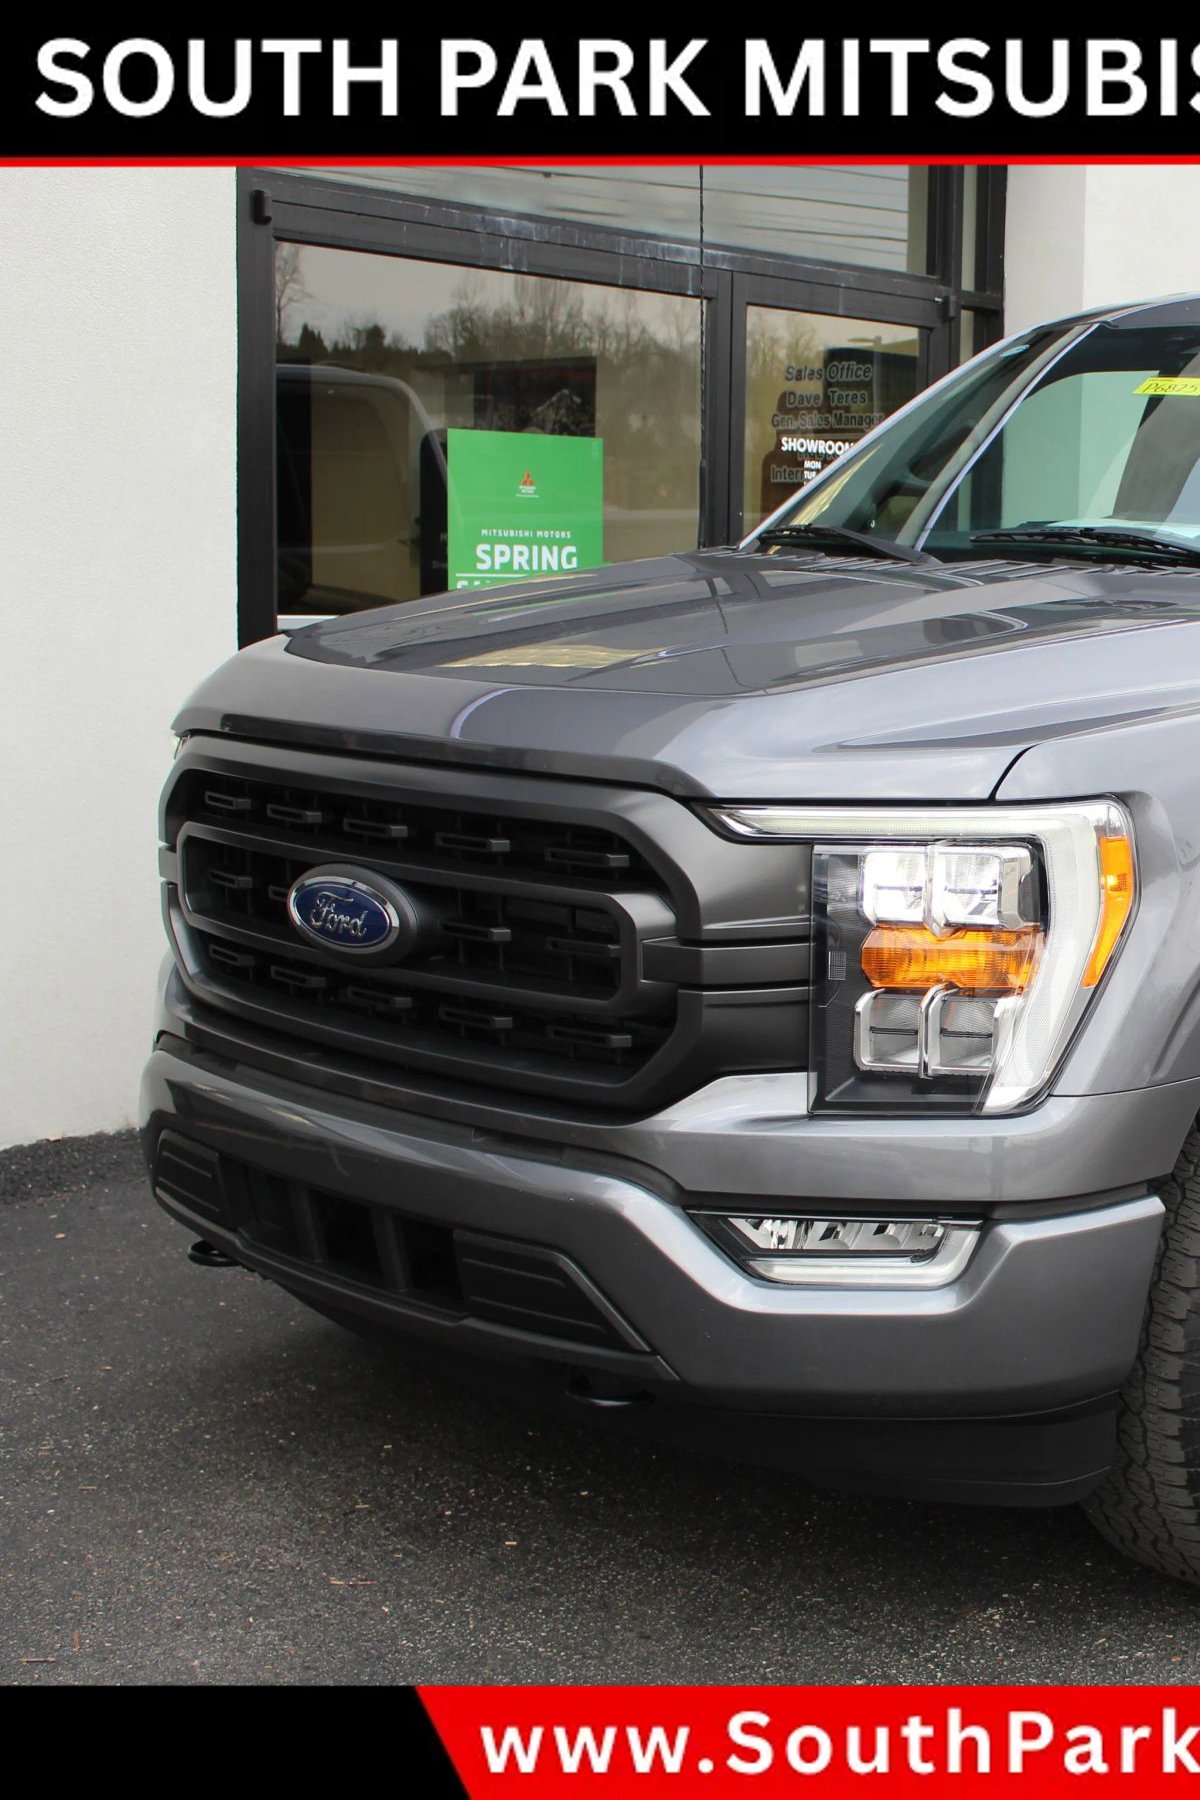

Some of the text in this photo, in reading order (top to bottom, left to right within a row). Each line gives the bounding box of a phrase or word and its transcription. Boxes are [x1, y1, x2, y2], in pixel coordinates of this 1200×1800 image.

[785, 362, 872, 382] Sales Office
[786, 387, 867, 407] Dave Teres
[772, 411, 884, 430] Gen. Sales Manager
[804, 460, 822, 470] MON
[480, 529, 572, 539] MITSUBISHI MOTORS
[475, 543, 578, 571] SPRING
[310, 890, 369, 937] Ford
